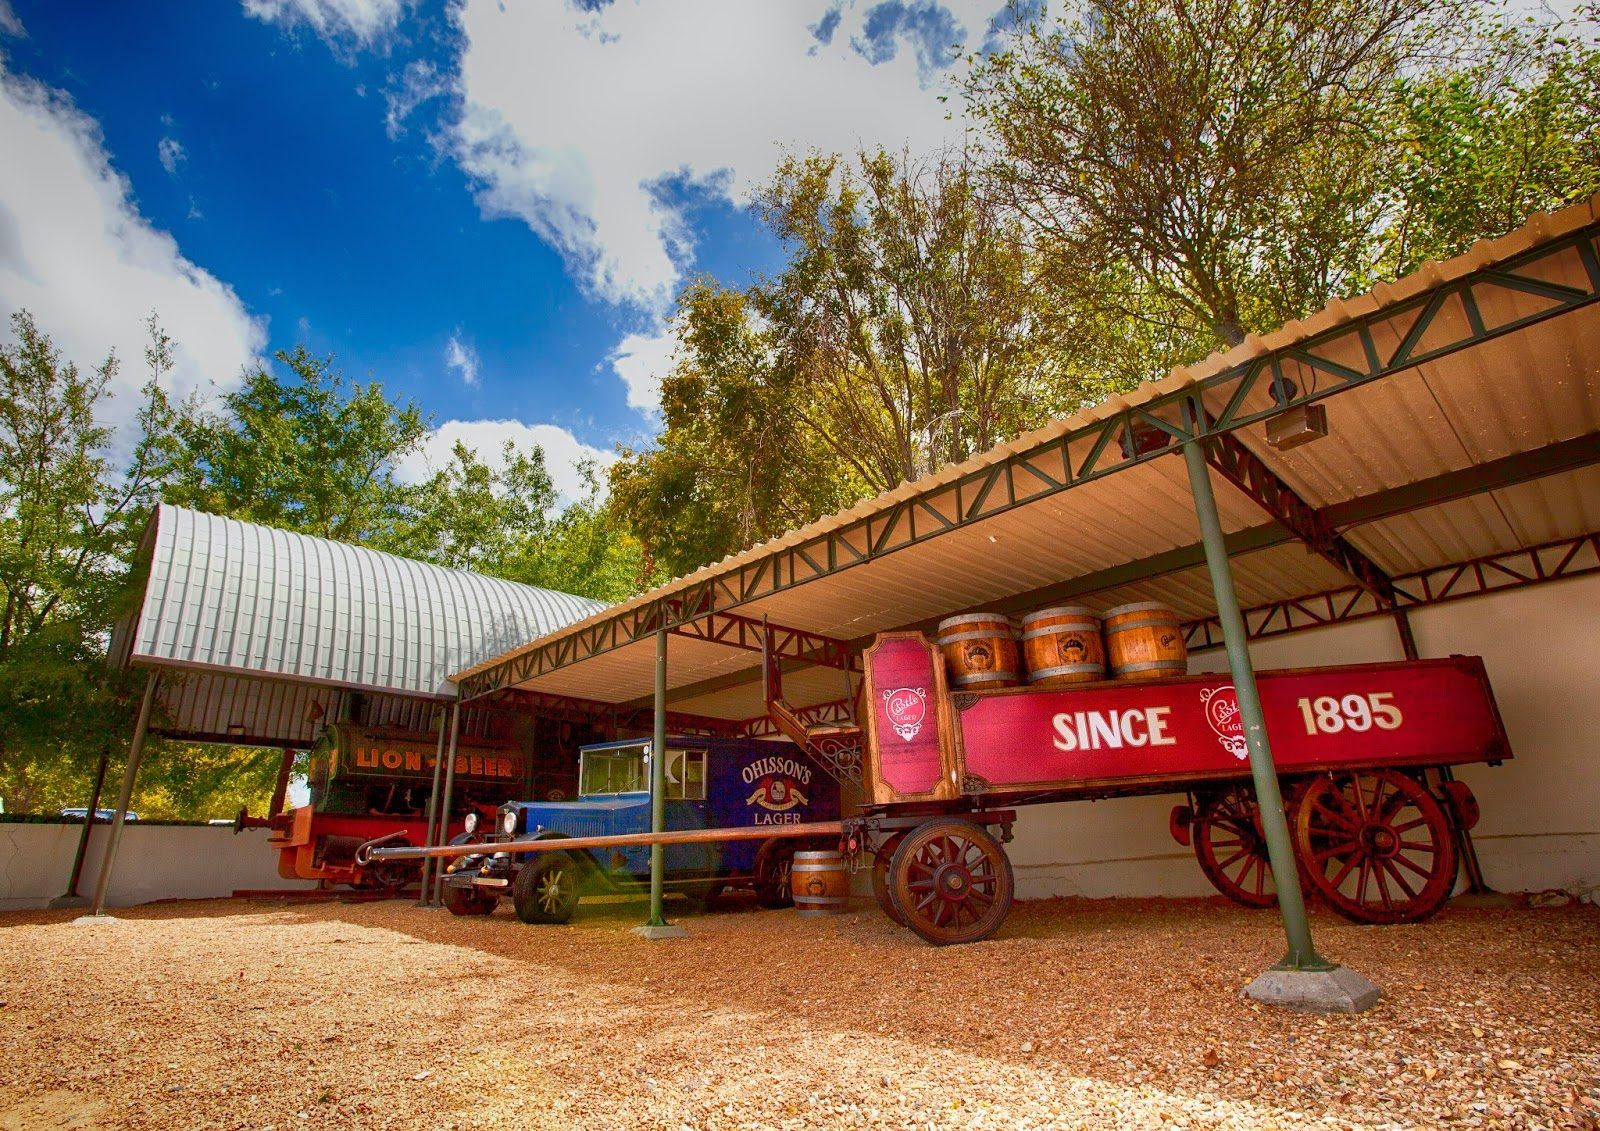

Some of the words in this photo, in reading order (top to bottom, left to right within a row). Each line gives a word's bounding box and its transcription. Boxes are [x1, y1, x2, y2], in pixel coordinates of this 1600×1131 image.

[891, 694, 919, 717] Castle
[1212, 700, 1240, 727] Cast
[1052, 705, 1177, 751] SINCE
[1297, 691, 1403, 735] 1895
[1222, 723, 1244, 731] LAGE
[356, 748, 421, 771] LION
[455, 755, 512, 777] BEER
[742, 756, 812, 784] OHLSSON'S
[754, 813, 801, 825] LAGER
